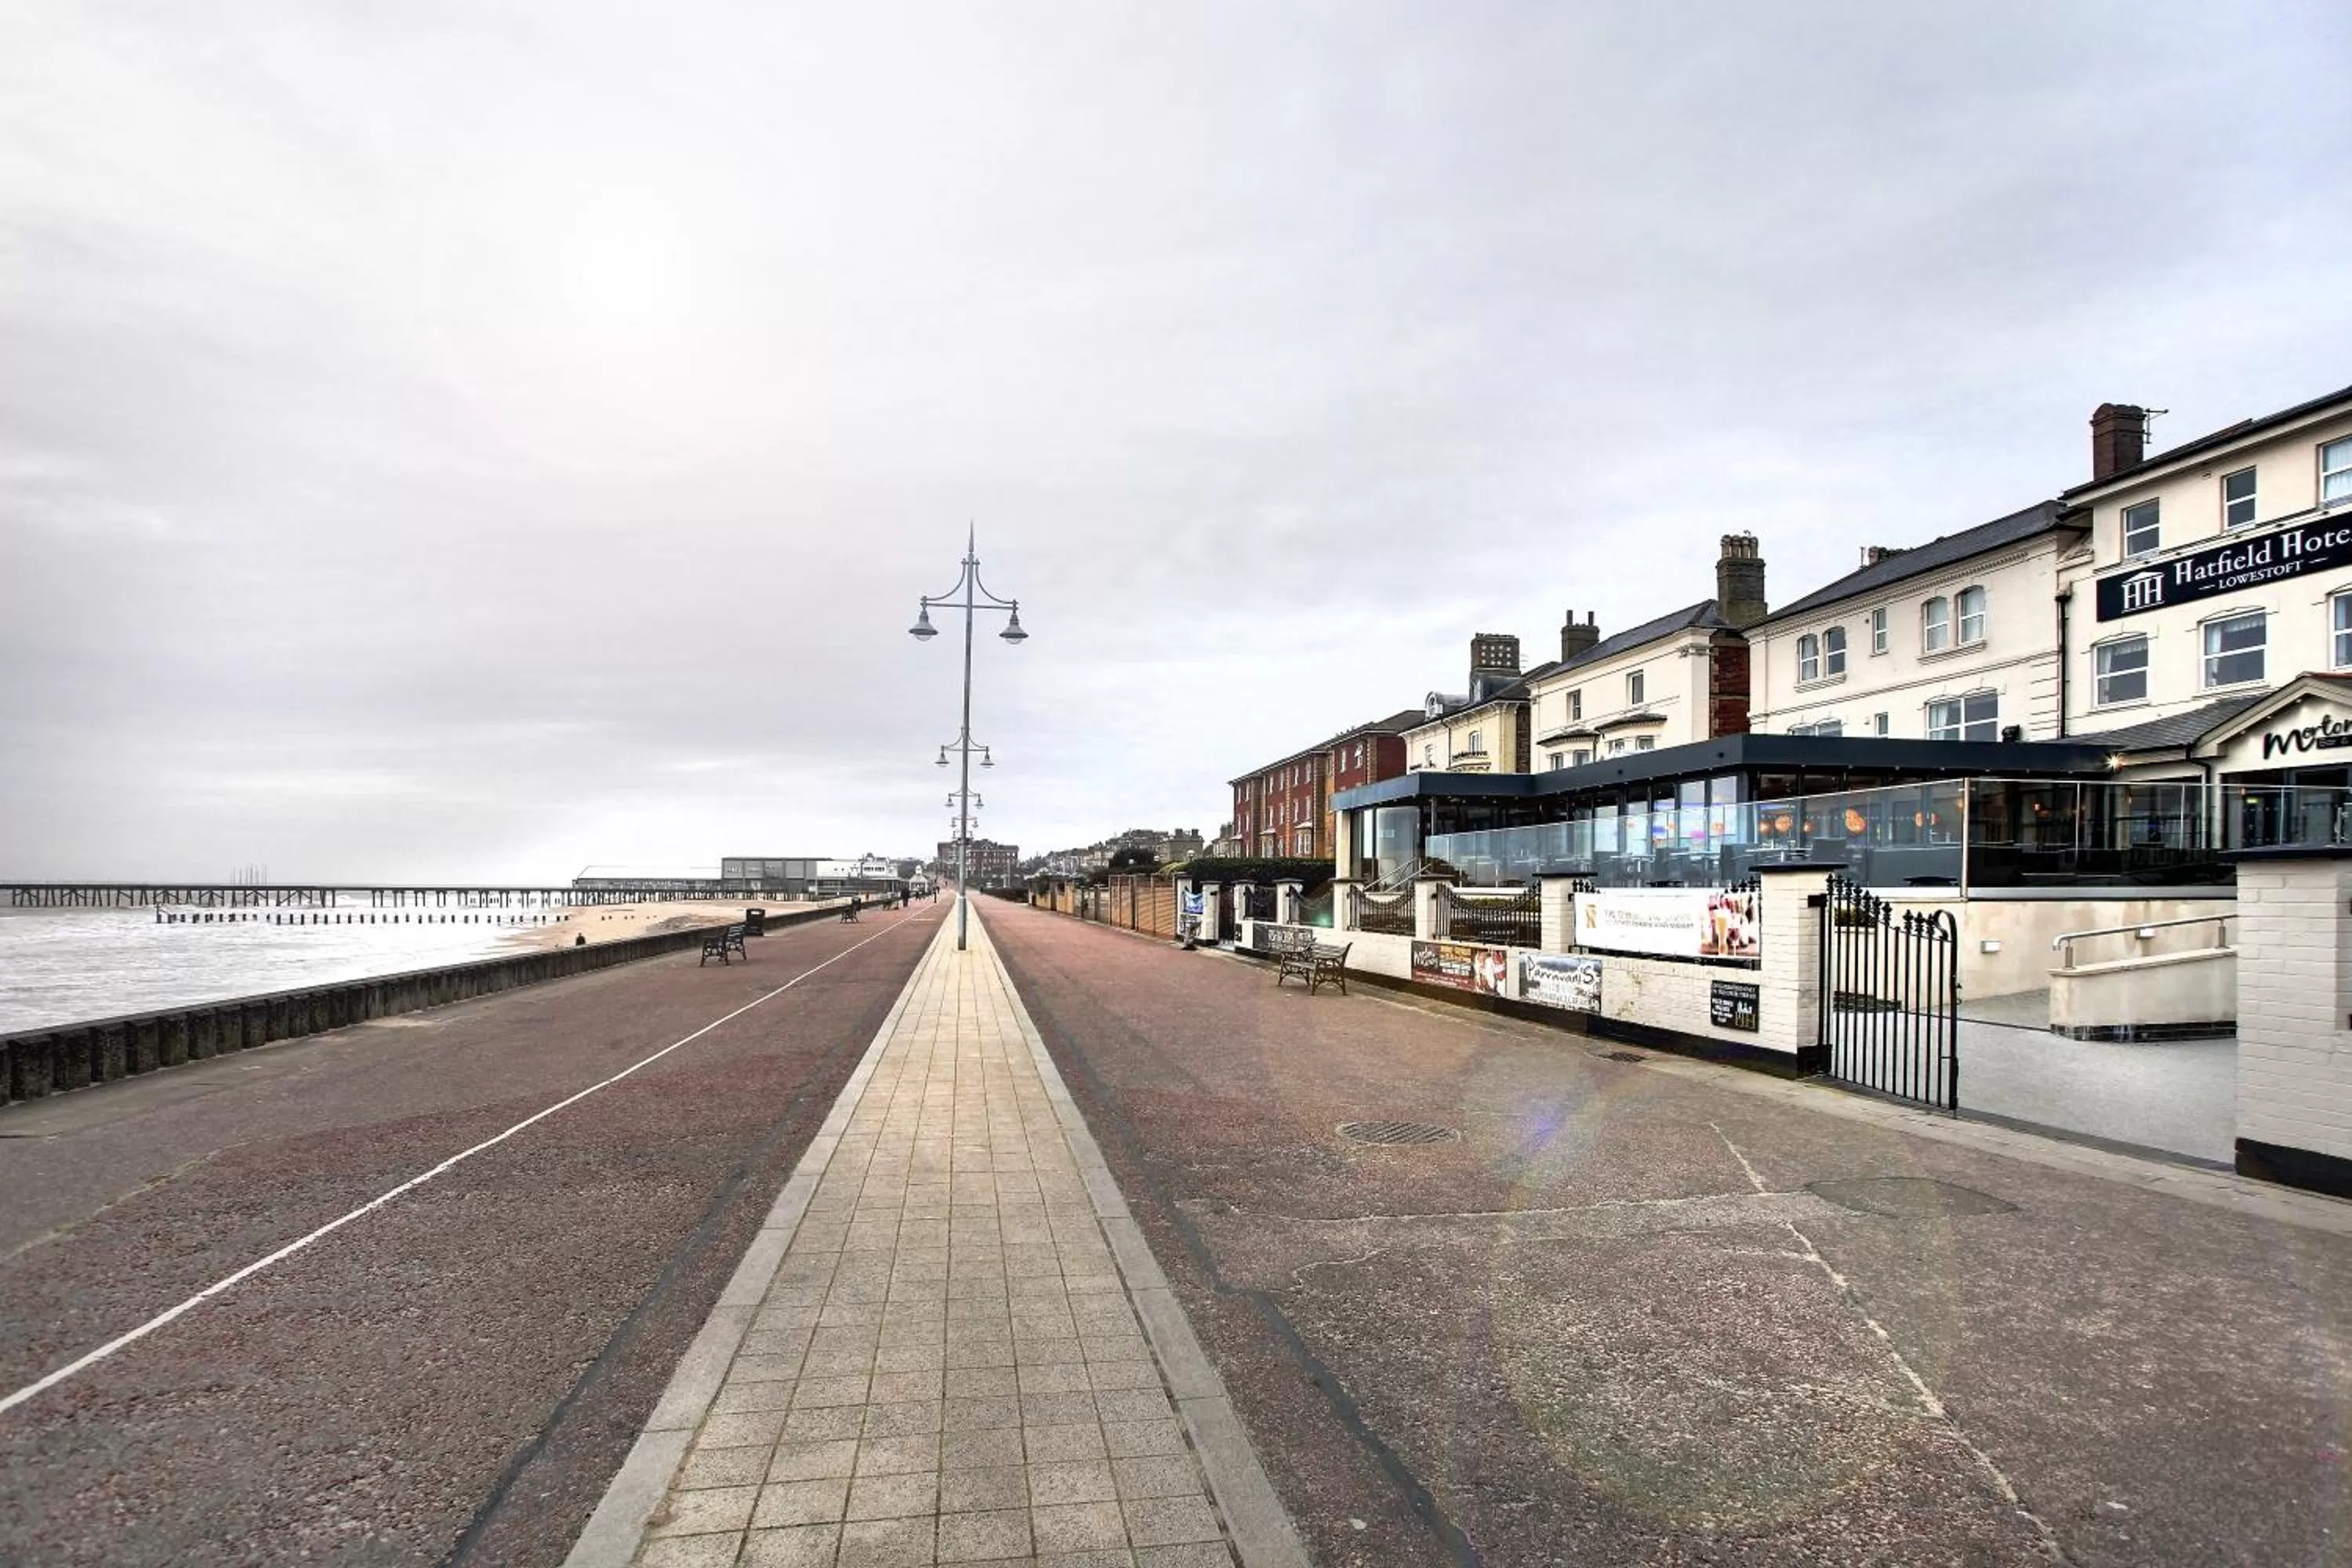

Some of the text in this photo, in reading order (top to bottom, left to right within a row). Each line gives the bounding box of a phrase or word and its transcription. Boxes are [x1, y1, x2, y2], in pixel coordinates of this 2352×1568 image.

[2173, 528, 2352, 586] Hatfield Hote
[2218, 559, 2304, 590] LOWESTOFT
